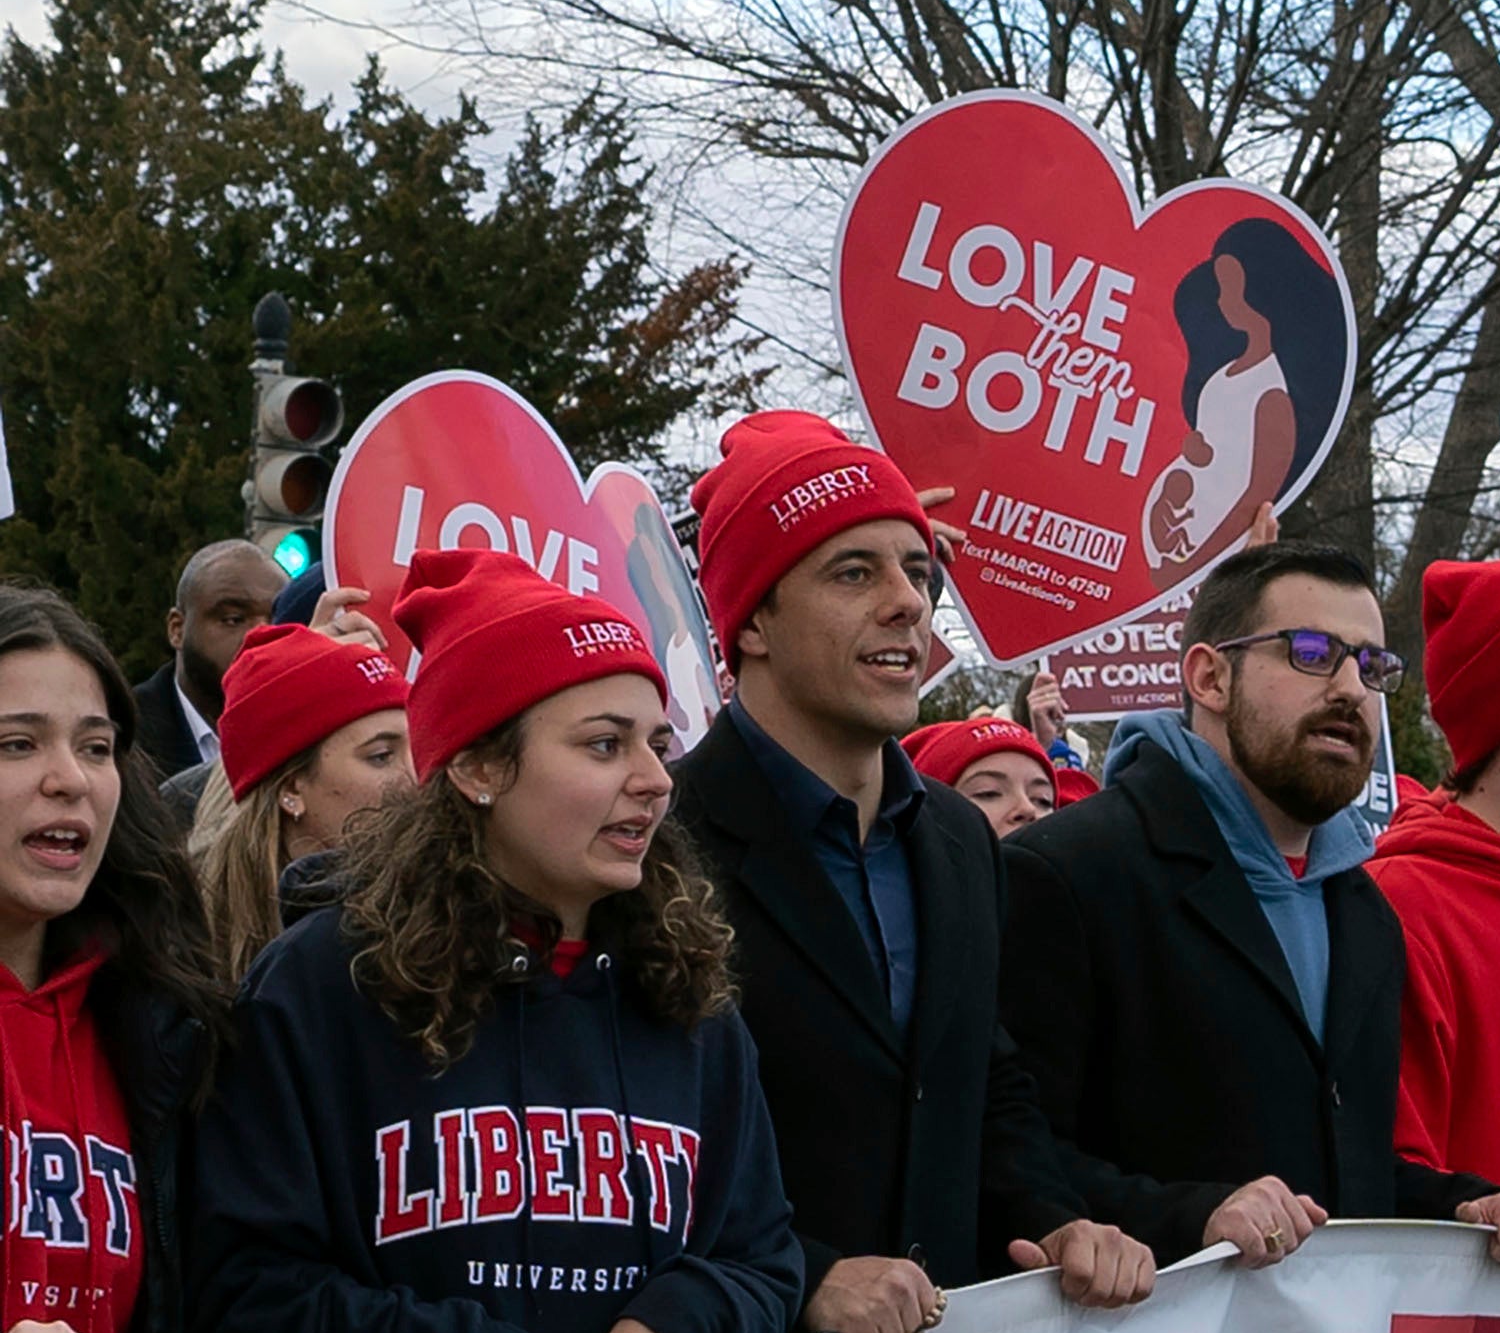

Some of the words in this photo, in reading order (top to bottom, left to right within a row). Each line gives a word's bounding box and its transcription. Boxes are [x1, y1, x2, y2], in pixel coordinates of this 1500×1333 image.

[897, 201, 1135, 353] LOVE
[1000, 295, 1135, 399] them
[897, 322, 1156, 478] BOTH
[769, 464, 872, 525] LIBERTY
[970, 488, 1041, 544] LIVE
[1036, 513, 1124, 570] ACTION
[960, 538, 991, 563] Text
[990, 547, 1051, 583] MARCH
[1051, 569, 1067, 588] to
[1067, 574, 1113, 602] 47581
[1053, 621, 1184, 656] OTEC
[1061, 665, 1097, 690] AT
[1100, 661, 1182, 688] CONC
[9, 1119, 137, 1258] RT
[467, 1260, 648, 1293] UNIVERSIT
